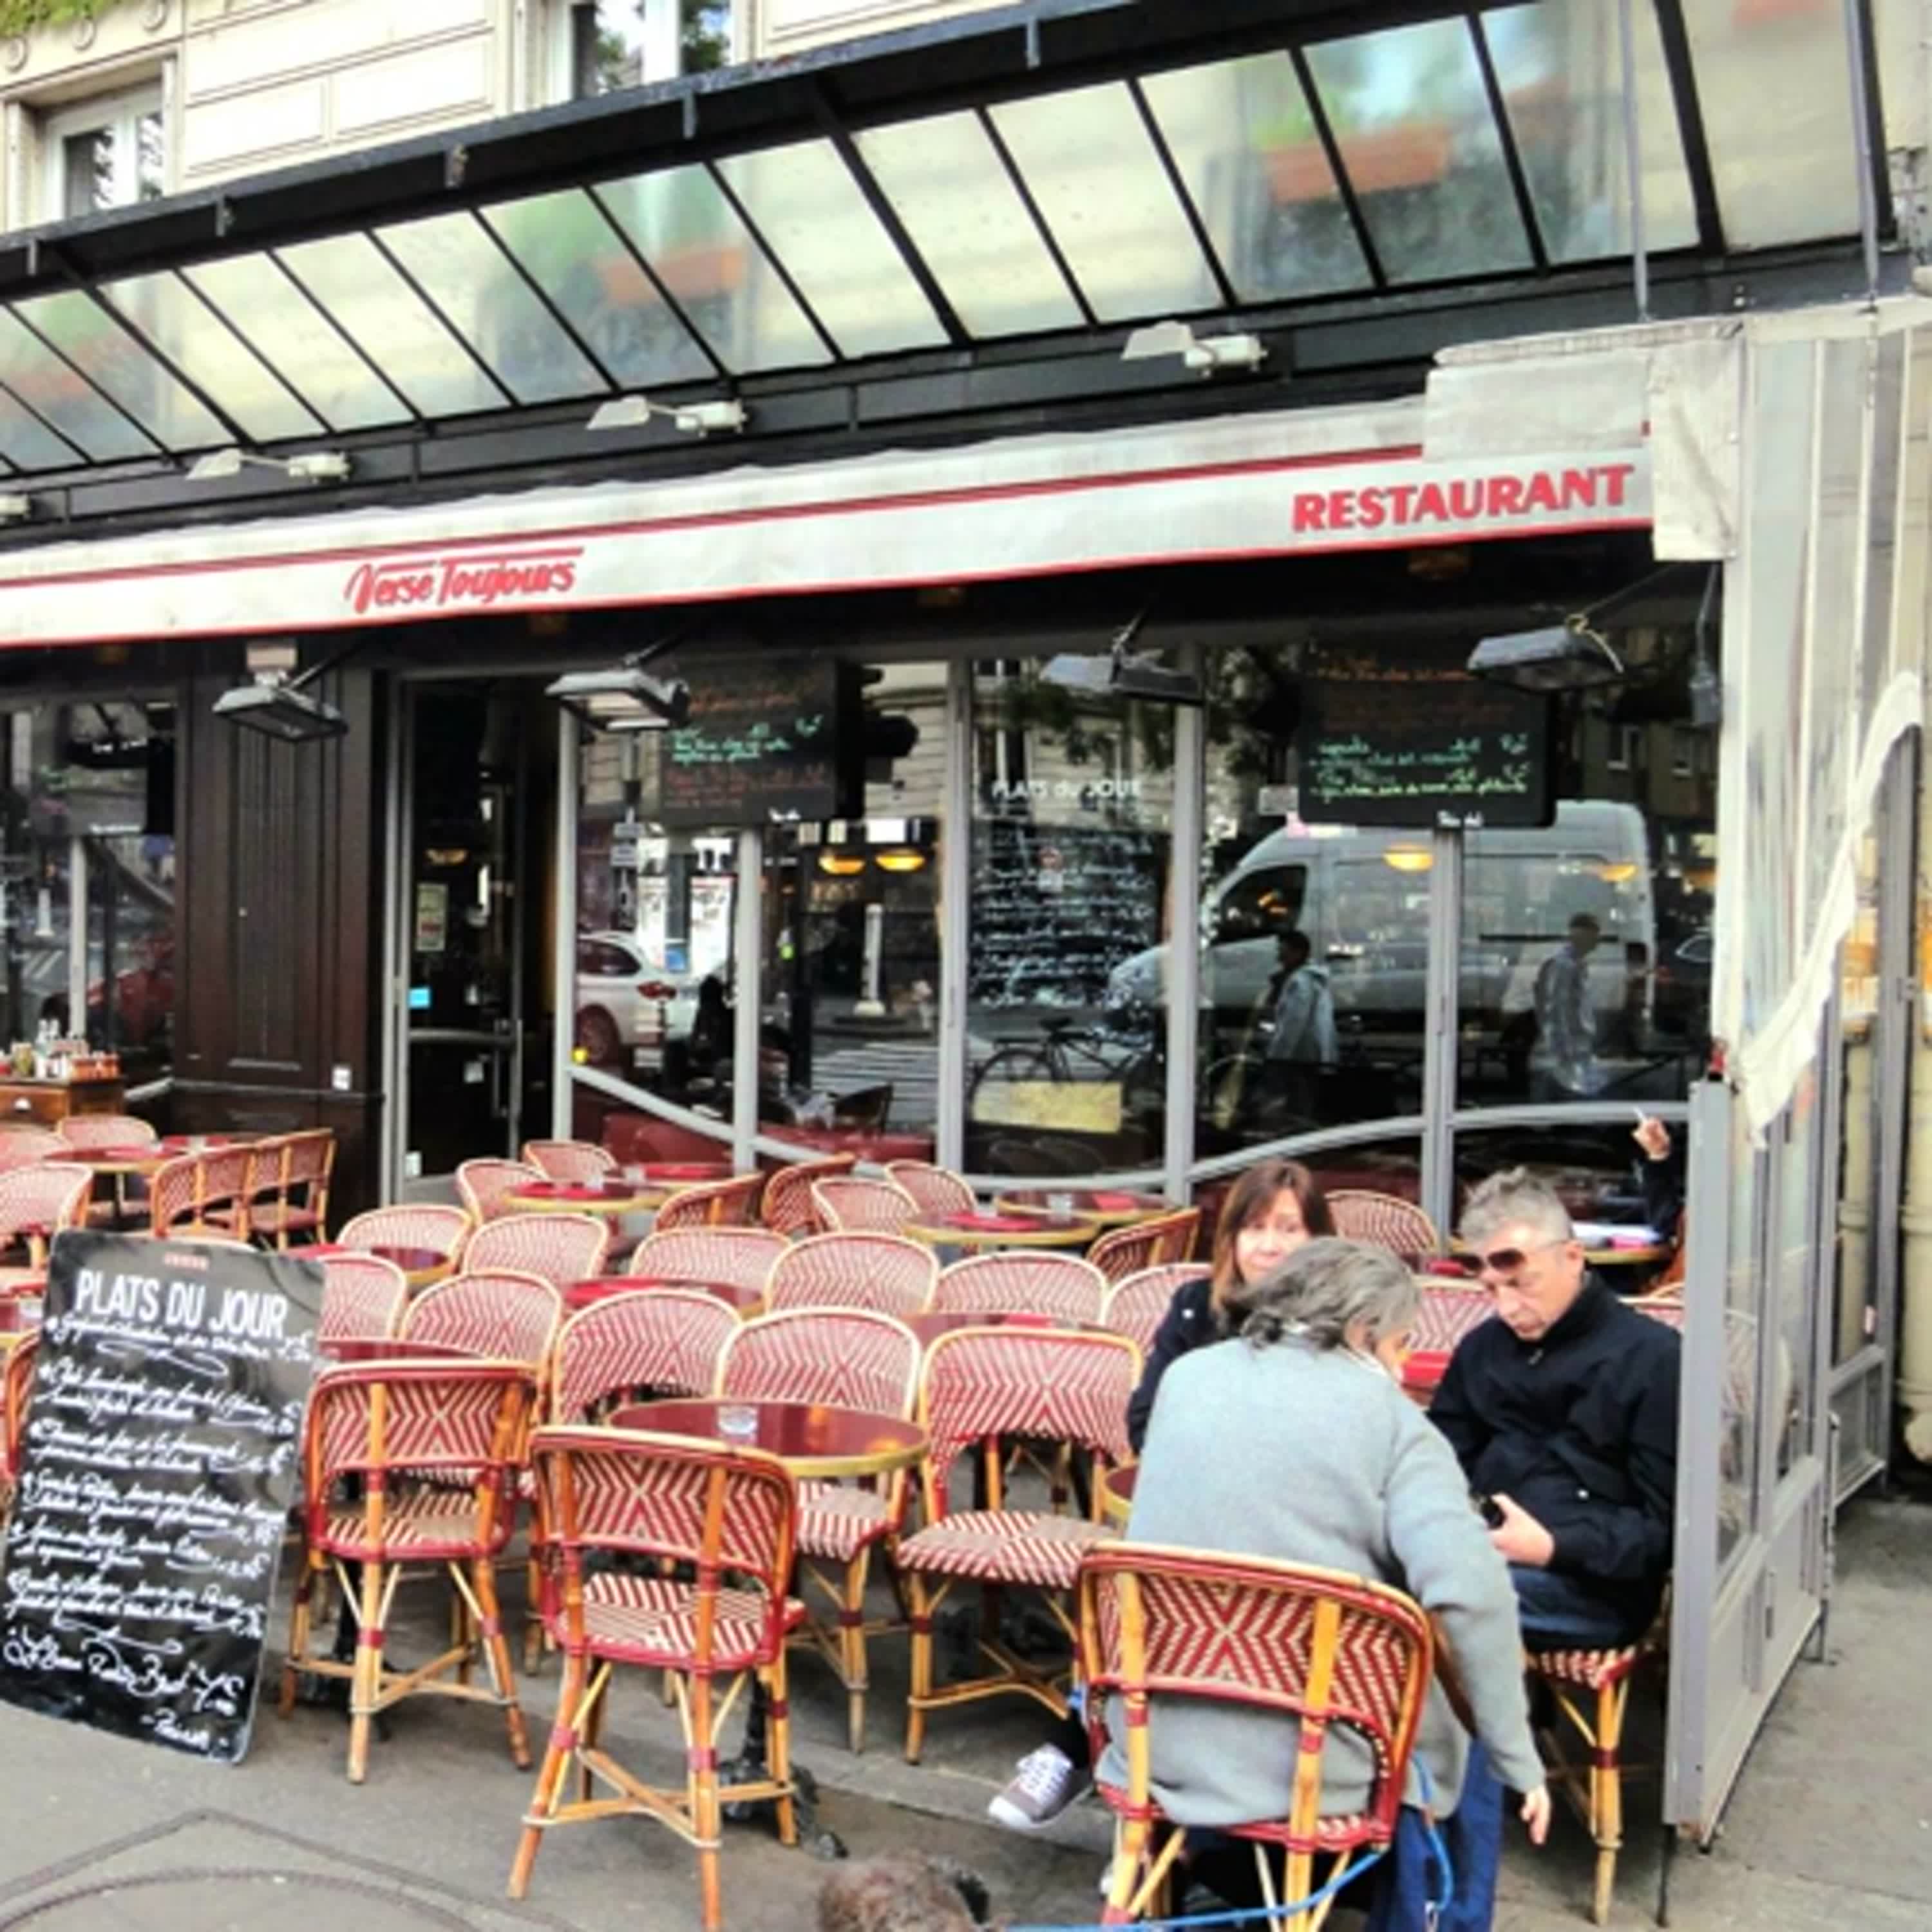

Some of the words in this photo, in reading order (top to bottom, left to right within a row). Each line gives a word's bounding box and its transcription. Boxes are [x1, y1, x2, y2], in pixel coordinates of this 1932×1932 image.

[1293, 464, 1635, 533] RESTAURANT
[344, 560, 437, 613] Verse
[438, 547, 584, 605] Toujours
[75, 1270, 160, 1321] PLATS
[166, 1282, 205, 1327] DU
[209, 1289, 288, 1340] JOUR
